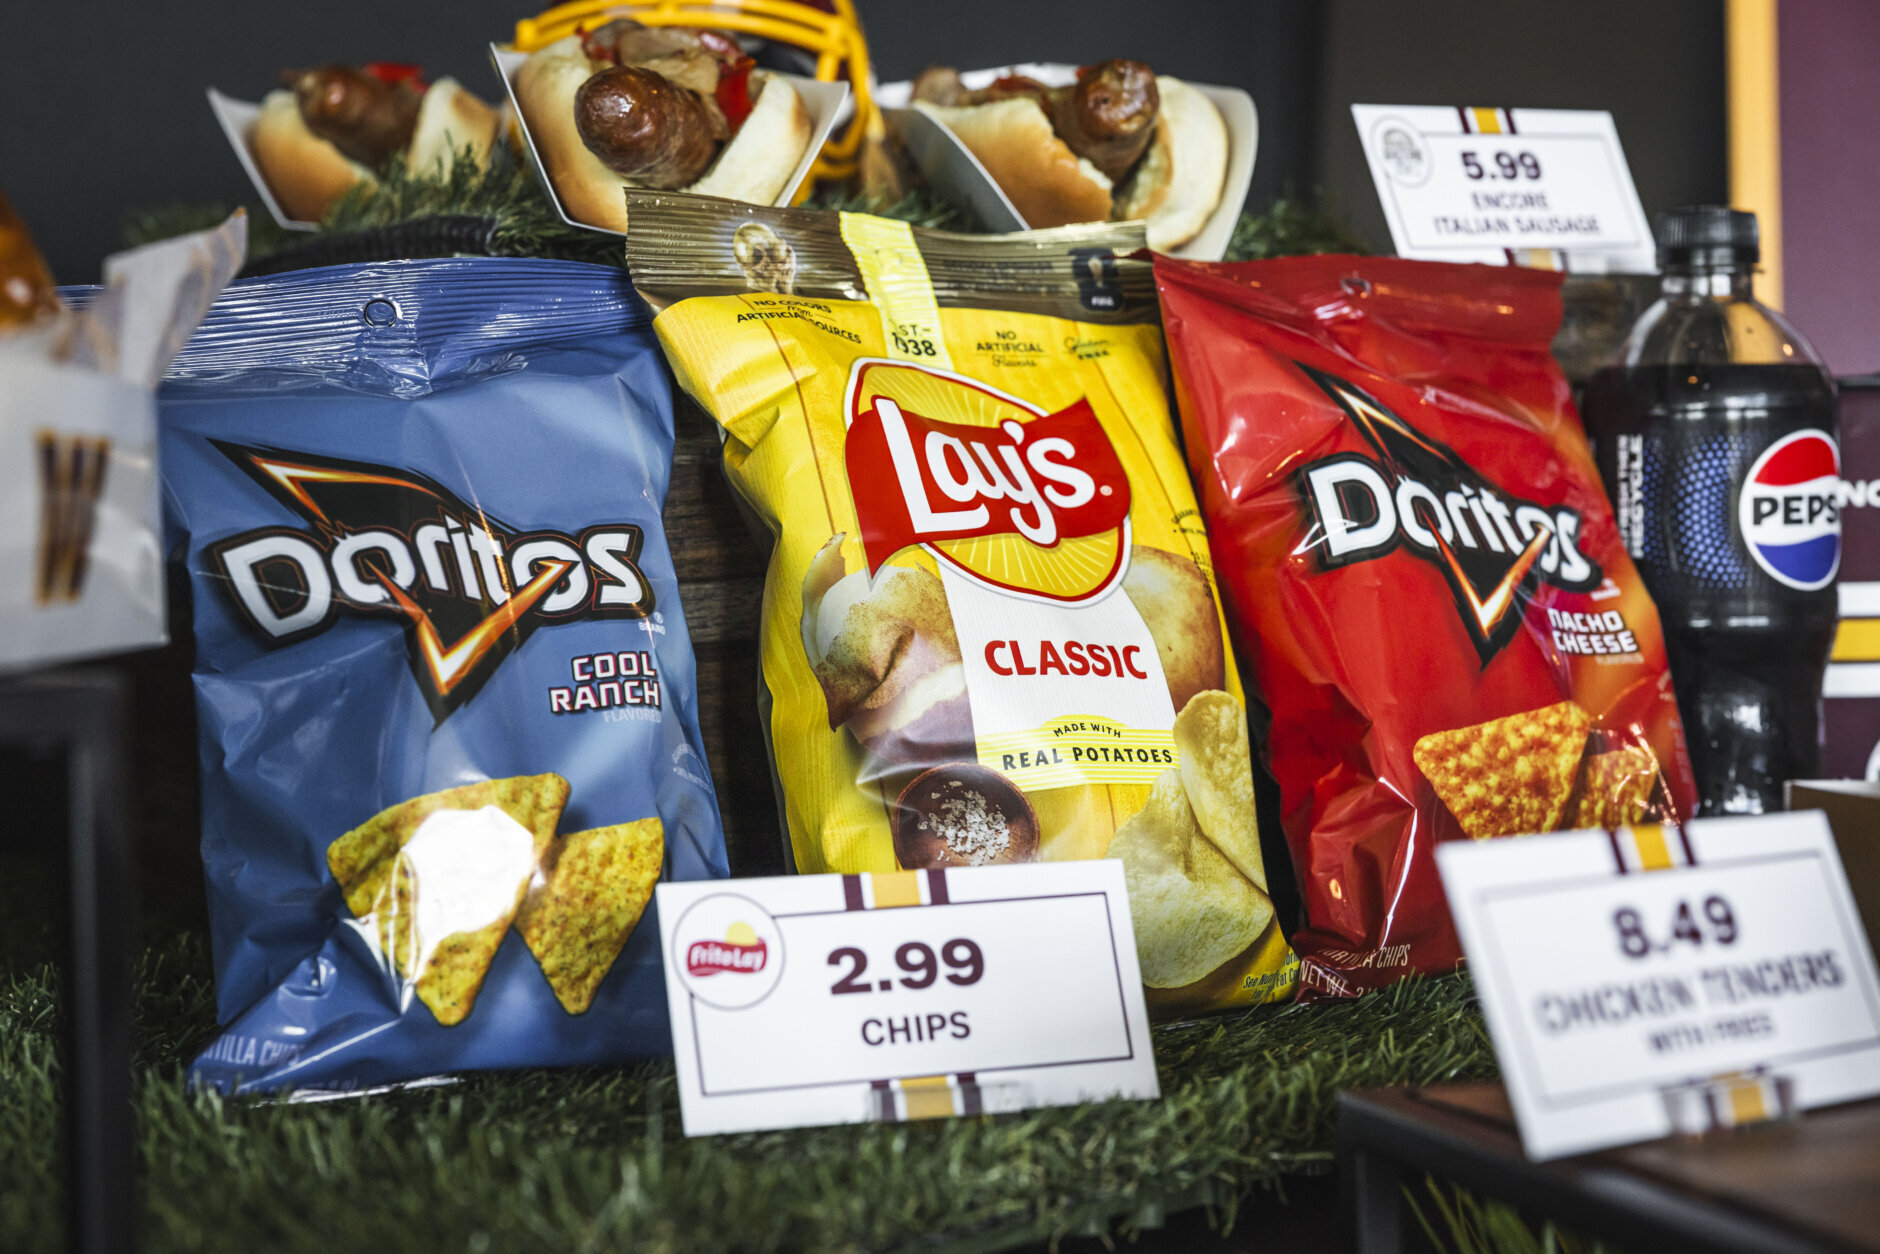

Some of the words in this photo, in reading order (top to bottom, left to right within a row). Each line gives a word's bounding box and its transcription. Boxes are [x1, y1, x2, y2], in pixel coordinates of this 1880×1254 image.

[1461, 151, 1542, 181] 5.99
[996, 331, 1017, 341] NO
[1309, 461, 1592, 582] Doritos
[1753, 494, 1837, 526] PEPS
[222, 514, 644, 638] Doritos
[1547, 607, 1624, 632] NACHO
[1552, 630, 1638, 654] CHEESE
[572, 651, 656, 681] COOL
[984, 640, 1148, 680] CLASSIC
[550, 680, 660, 713] RANCH
[1053, 722, 1087, 738] MADE
[1090, 723, 1122, 739] WITH
[1002, 748, 1063, 771] REAL
[1072, 747, 1173, 764] POTATOES
[1614, 896, 1738, 957] 8.49
[827, 938, 984, 995] 2.99
[1377, 944, 1411, 969] CHIPS
[1300, 960, 1322, 987] NET
[861, 1011, 971, 1046] CHIPS
[202, 1034, 256, 1066] TILLA
